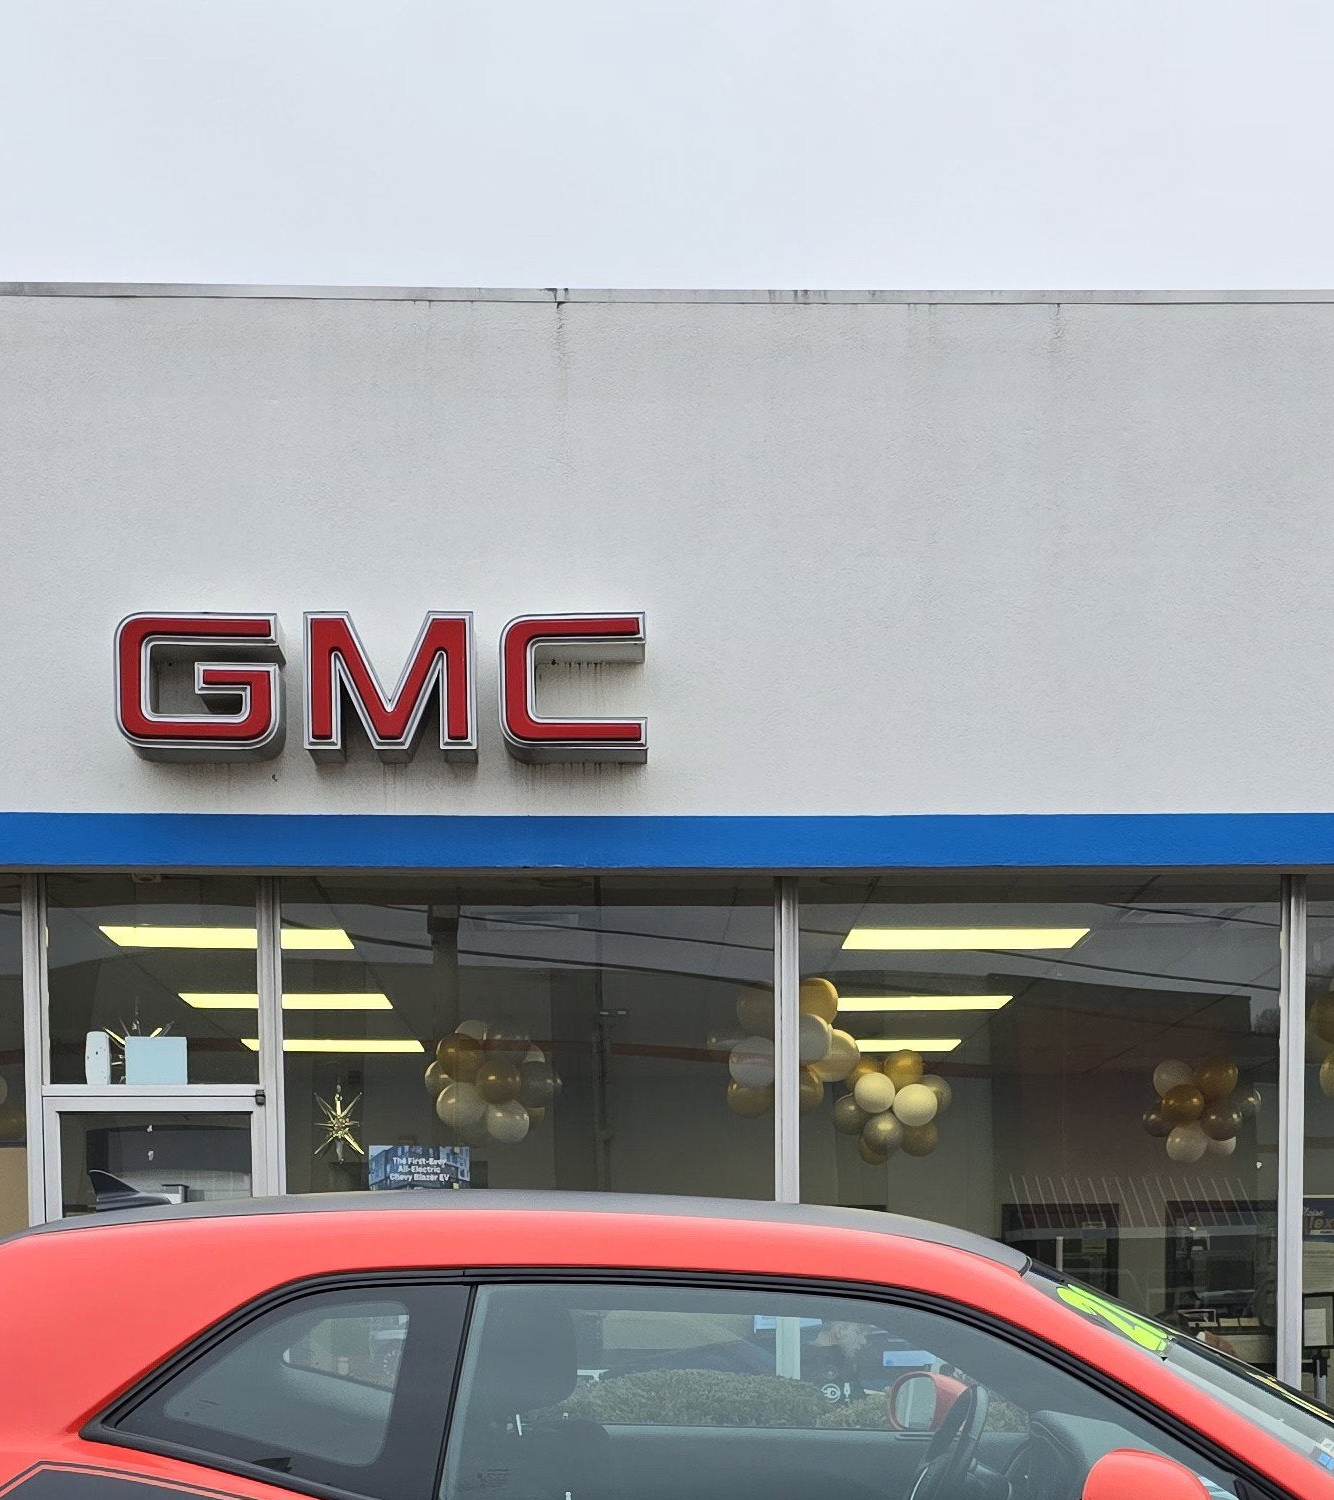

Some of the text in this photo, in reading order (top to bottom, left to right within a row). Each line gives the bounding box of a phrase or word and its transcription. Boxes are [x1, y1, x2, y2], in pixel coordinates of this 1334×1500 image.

[113, 610, 647, 757] GMC
[393, 1157, 406, 1165] The
[389, 1173, 413, 1181] Chevy
[439, 1173, 450, 1181] EV
